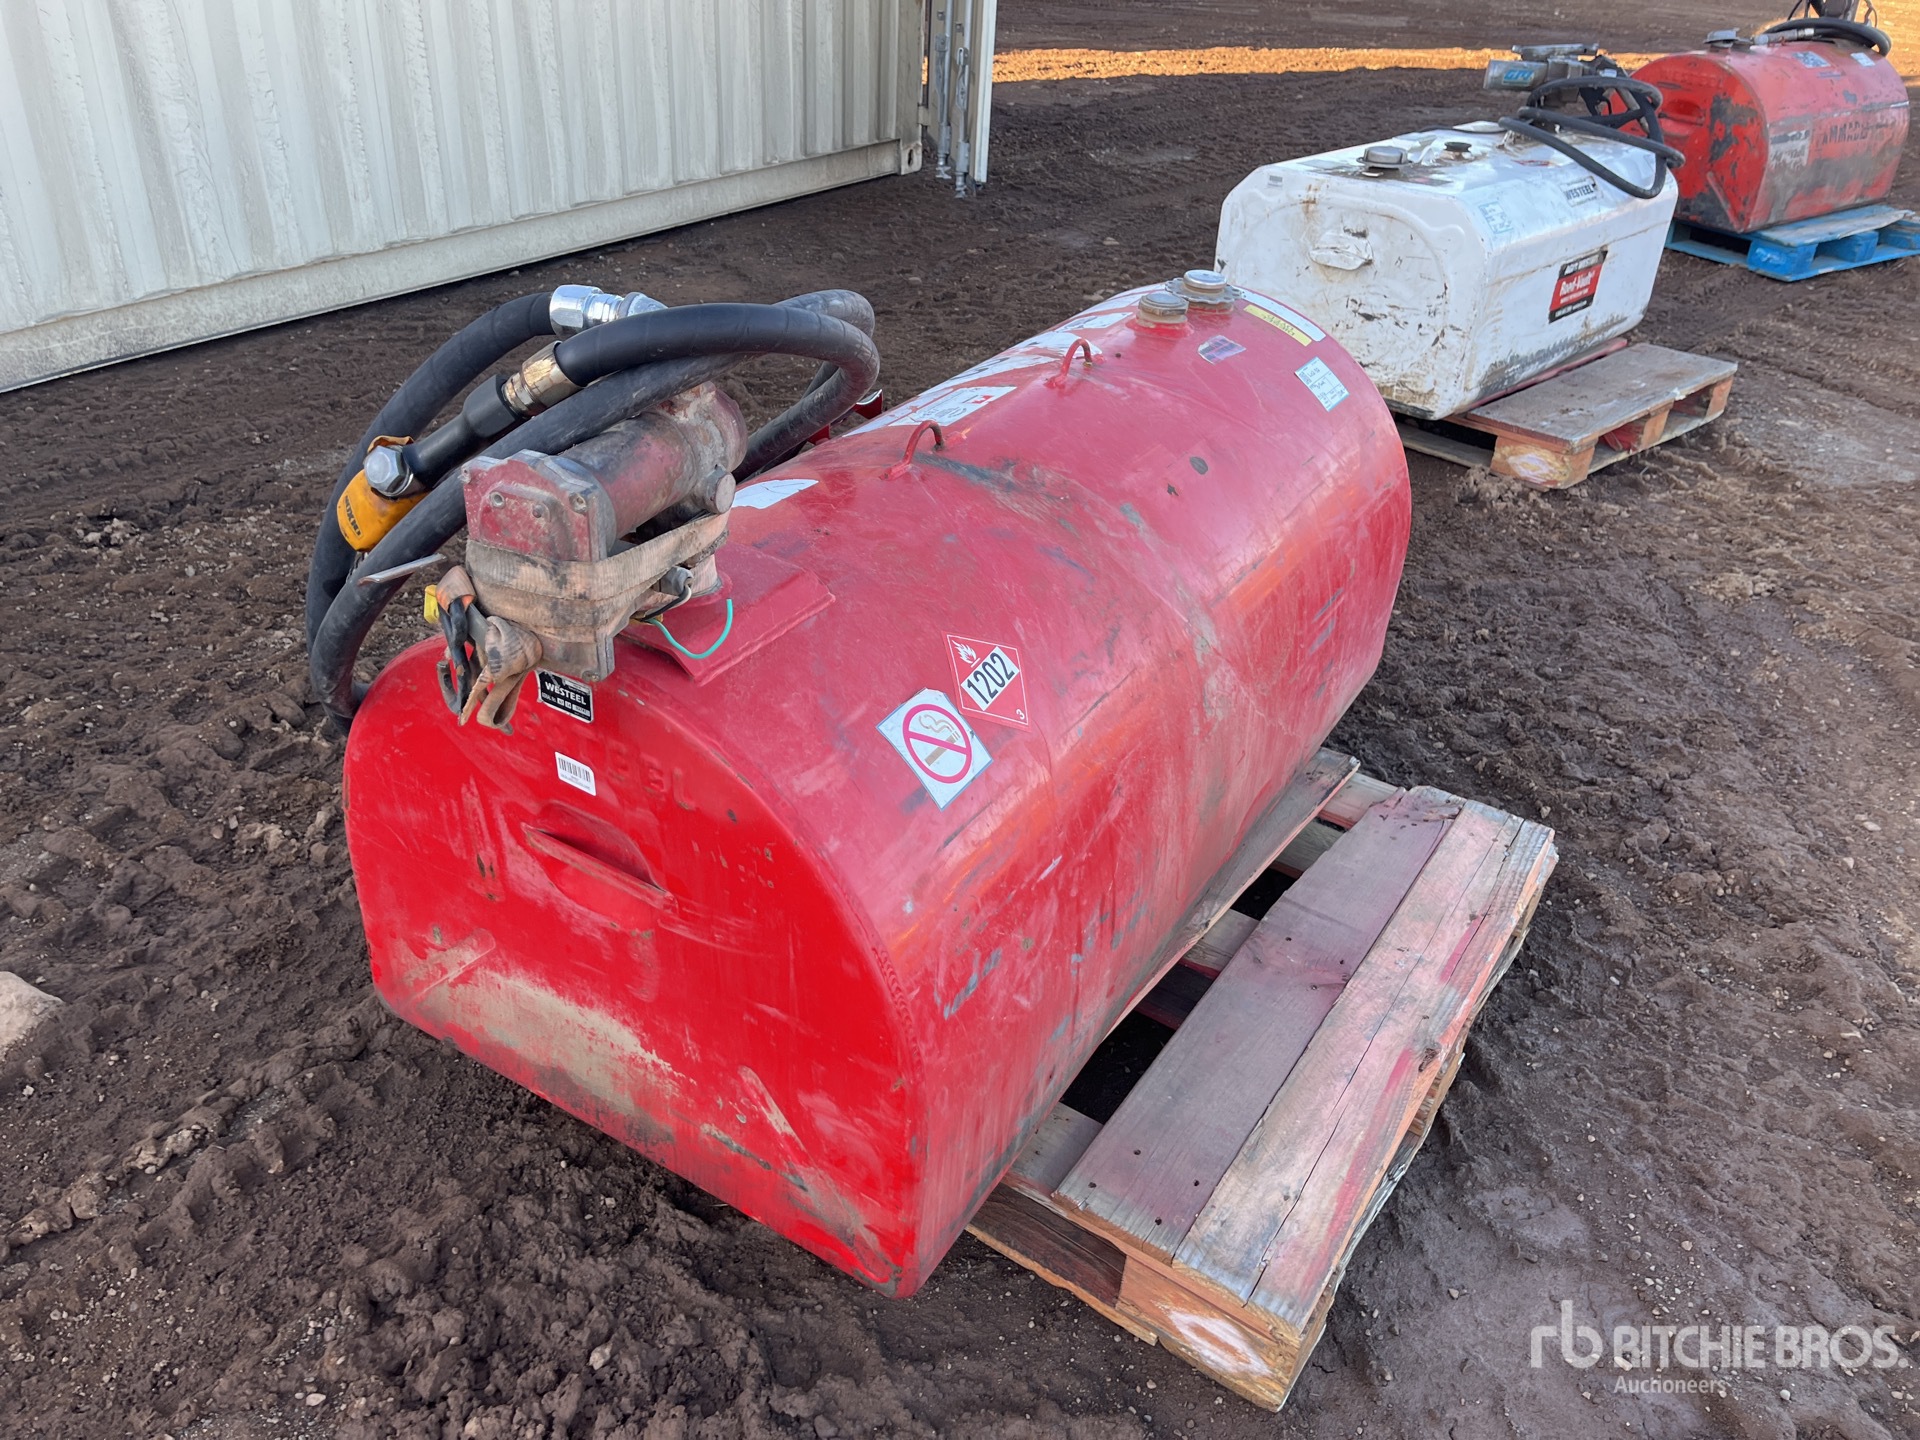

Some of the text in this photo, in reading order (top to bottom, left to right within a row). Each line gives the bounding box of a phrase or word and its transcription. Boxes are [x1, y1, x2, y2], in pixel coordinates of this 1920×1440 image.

[1565, 184, 1594, 200] WESTEEL
[966, 652, 1015, 704] 1202
[545, 681, 587, 706] WESTEEL
[1015, 708, 1025, 720] 3
